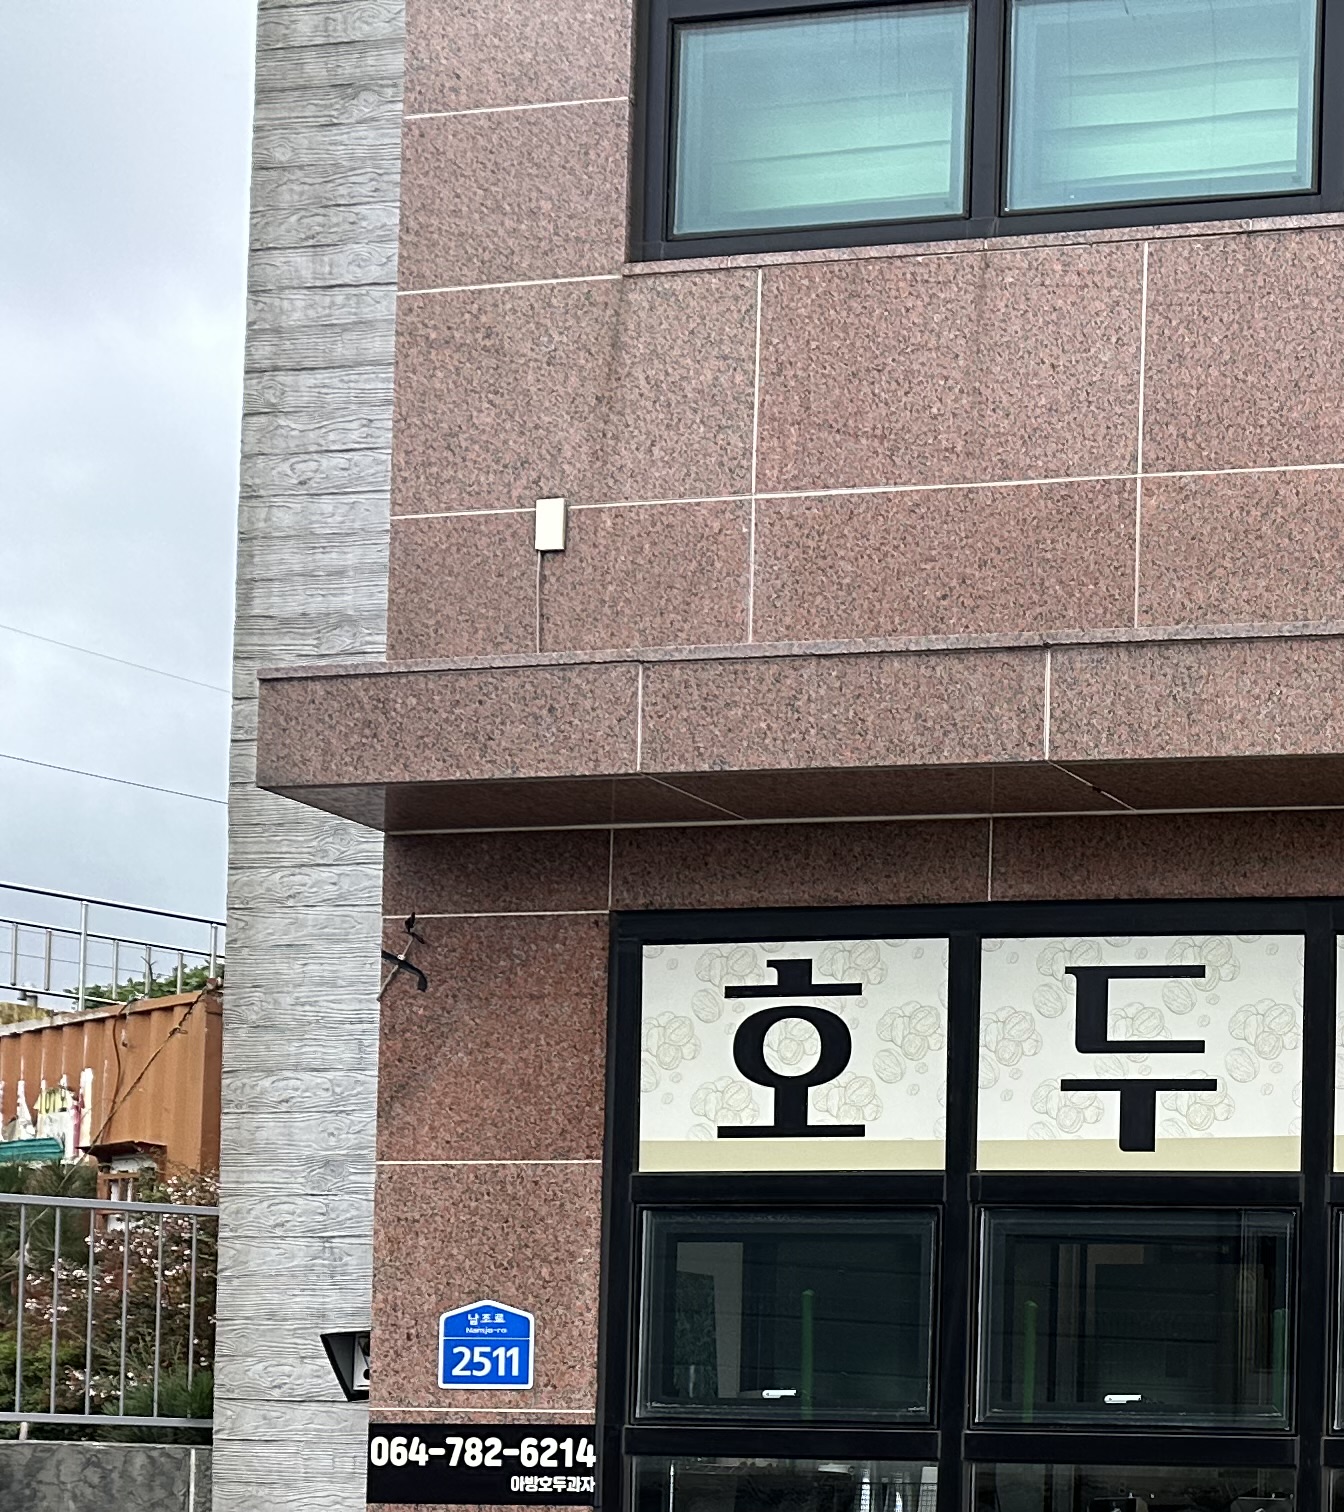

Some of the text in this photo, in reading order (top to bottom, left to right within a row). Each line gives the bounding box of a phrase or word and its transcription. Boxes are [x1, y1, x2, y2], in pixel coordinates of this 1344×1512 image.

[451, 1346, 519, 1376] 2511
[370, 1436, 597, 1468] 064-782-6214
[510, 1475, 596, 1493] 아방호두과자
